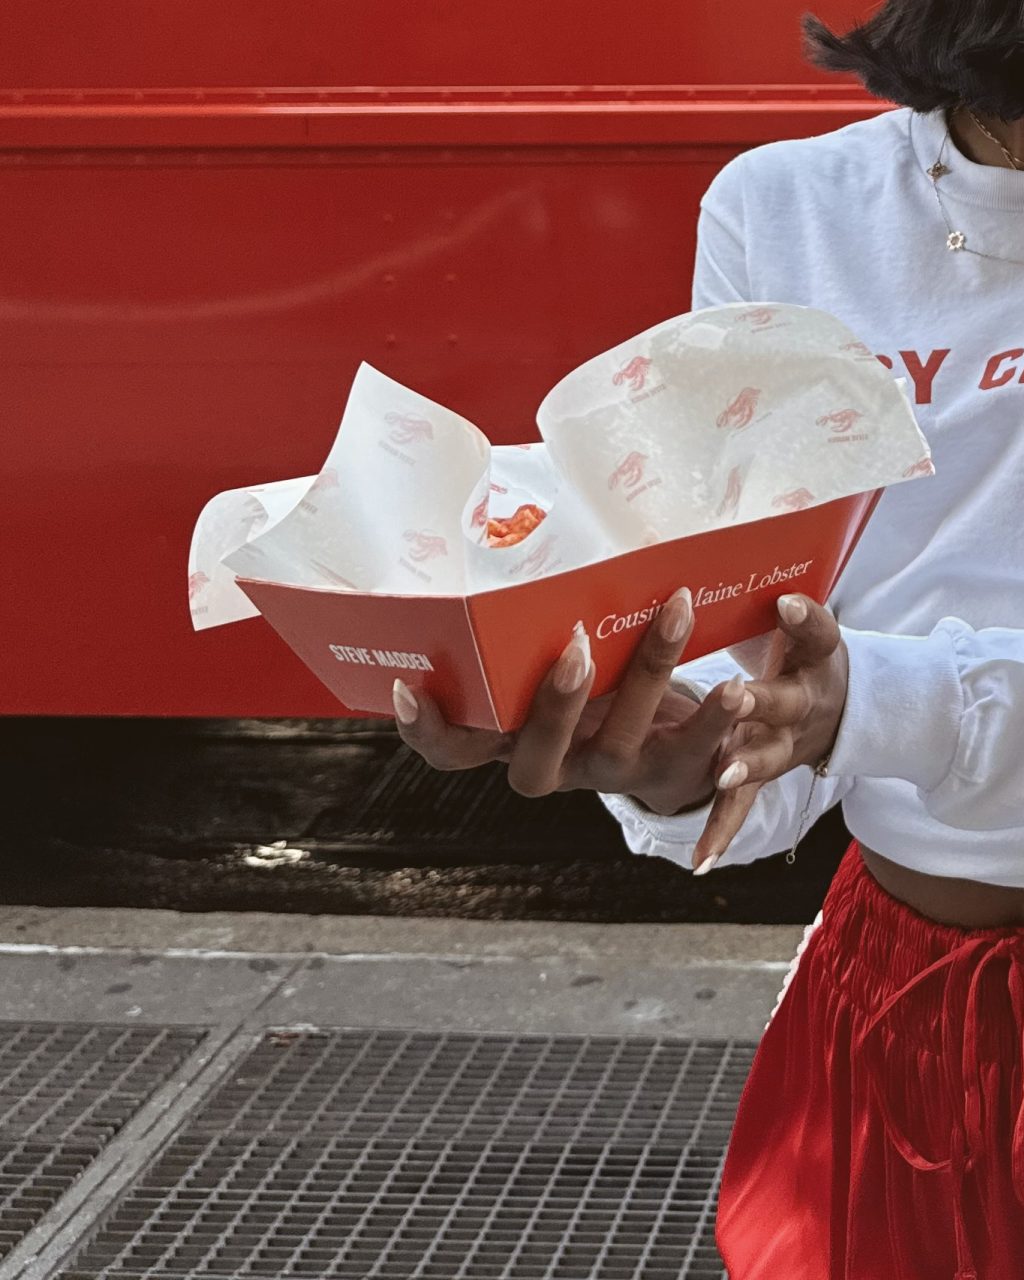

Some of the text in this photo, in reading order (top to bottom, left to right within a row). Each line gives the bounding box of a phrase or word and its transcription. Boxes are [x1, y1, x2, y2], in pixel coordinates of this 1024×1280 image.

[875, 348, 952, 405] Y
[745, 560, 814, 593] Lobster
[328, 643, 435, 672] STEVE MADDEN
